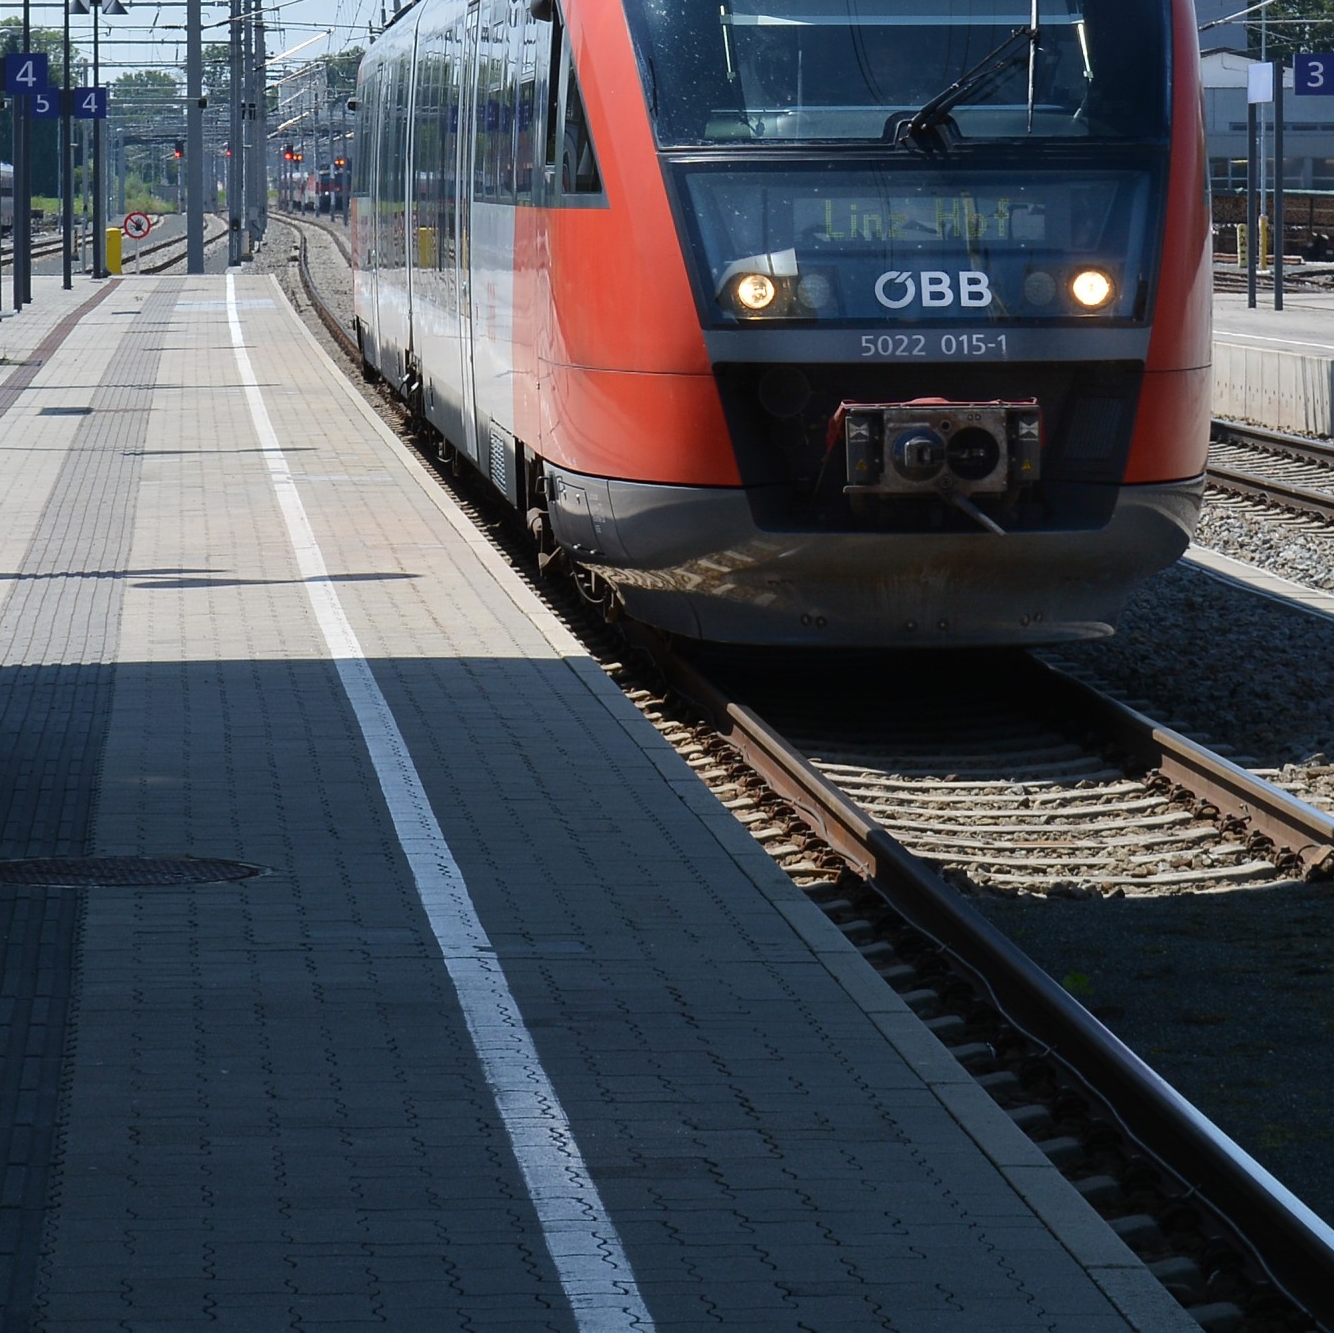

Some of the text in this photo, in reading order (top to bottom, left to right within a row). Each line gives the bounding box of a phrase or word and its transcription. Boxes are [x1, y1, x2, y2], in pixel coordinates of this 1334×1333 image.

[15, 60, 37, 87] 4
[1307, 61, 1324, 87] 3
[36, 94, 50, 113] 5
[82, 92, 98, 113] 4
[824, 198, 1011, 238] Linz Hbf
[874, 270, 993, 310] ÖBB
[860, 333, 1008, 357] 5022 015-1
